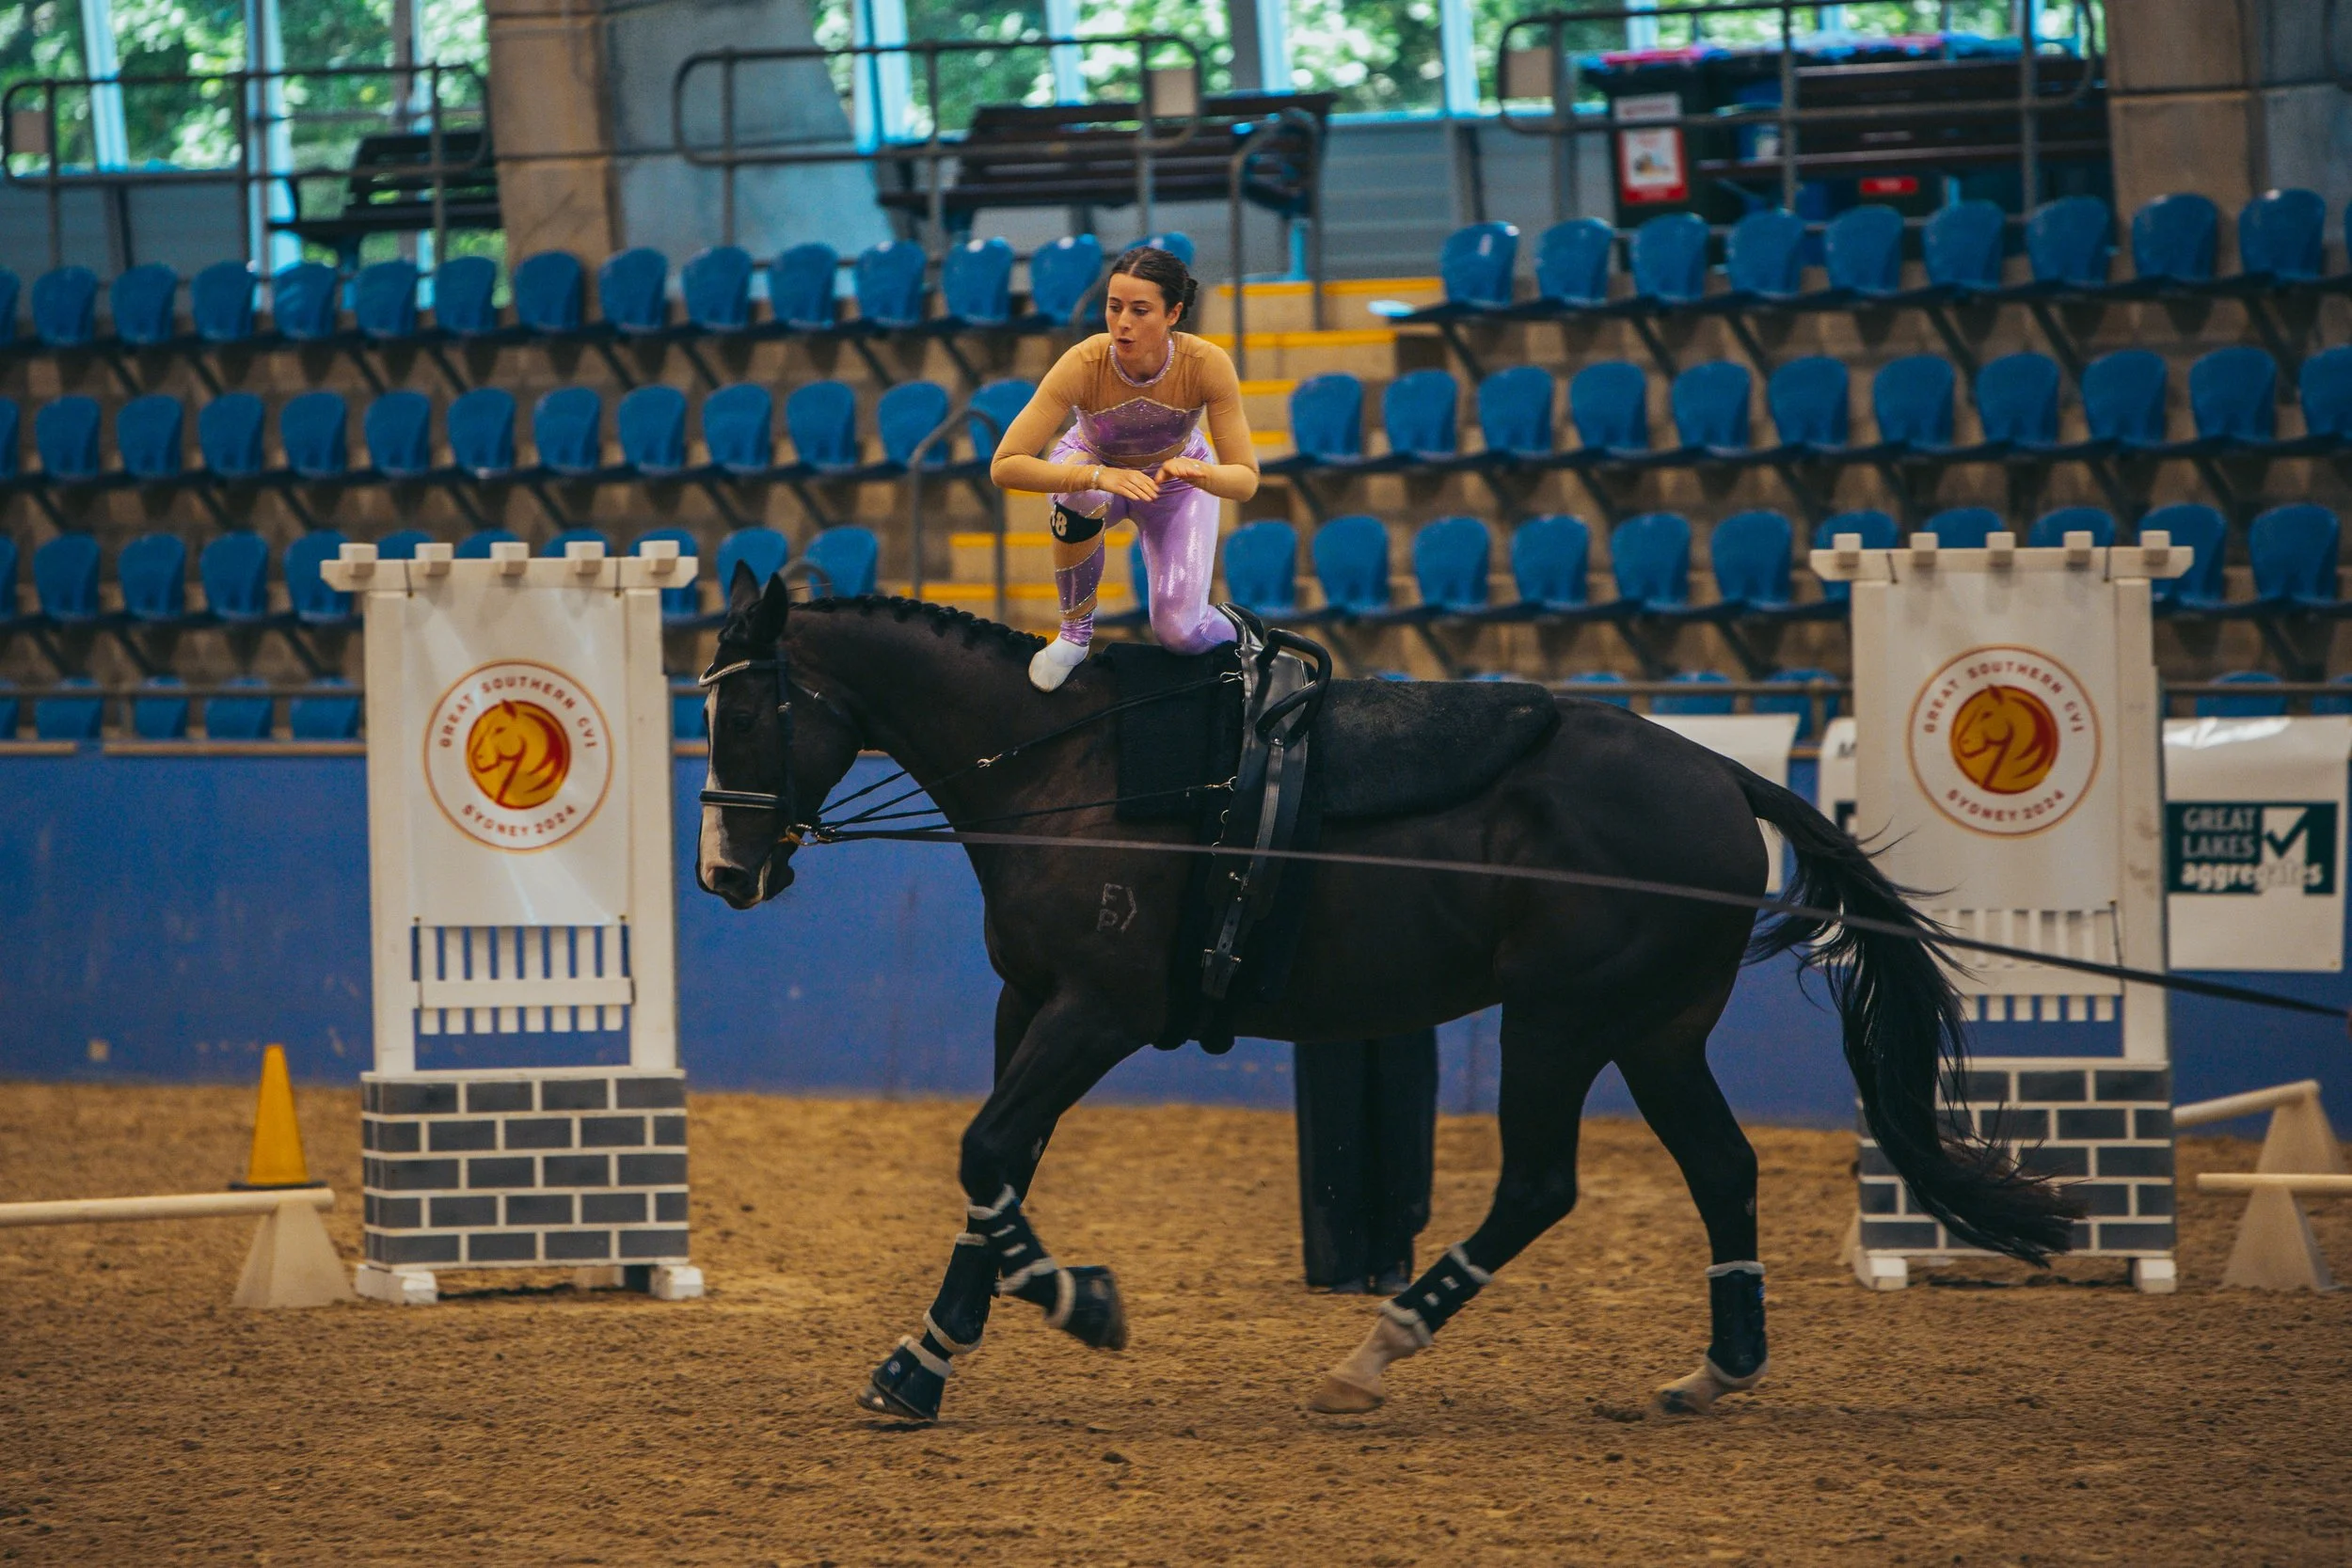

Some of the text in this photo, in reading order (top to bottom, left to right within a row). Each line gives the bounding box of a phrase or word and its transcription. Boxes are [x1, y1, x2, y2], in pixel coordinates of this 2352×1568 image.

[438, 675, 598, 749] GREAT SOUTHERN CVI
[1923, 661, 2085, 734] GREAT SOUTHERN CVI
[462, 804, 576, 837] SYDNEY 2024
[1946, 788, 2065, 822] SYDNEY 2024
[2182, 806, 2256, 832] GREAT
[2181, 834, 2256, 860] LAKES
[2180, 862, 2324, 893] aggregates
